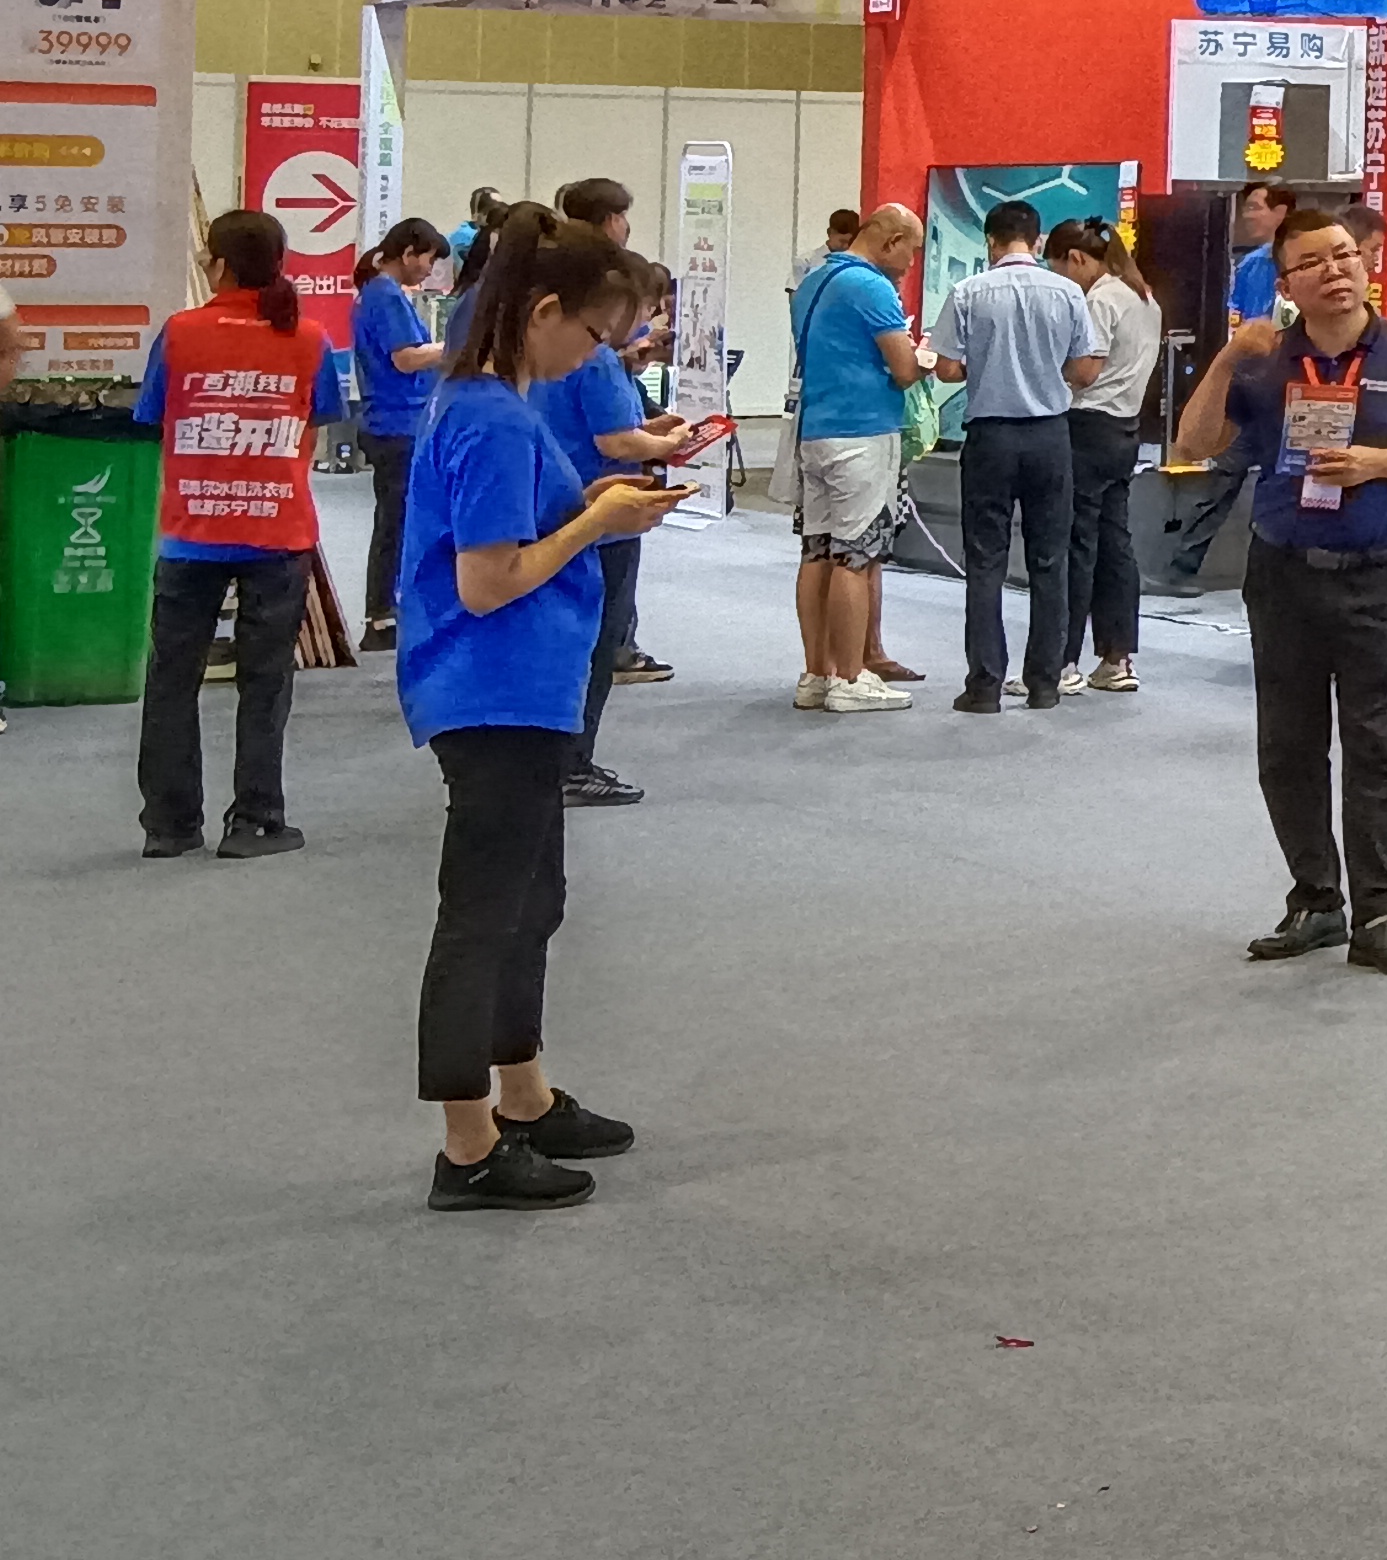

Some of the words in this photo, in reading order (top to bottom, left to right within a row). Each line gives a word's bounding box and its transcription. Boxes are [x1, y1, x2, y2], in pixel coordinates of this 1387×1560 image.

[38, 29, 132, 57] 39999
[1198, 29, 1324, 60] 苏宁易购
